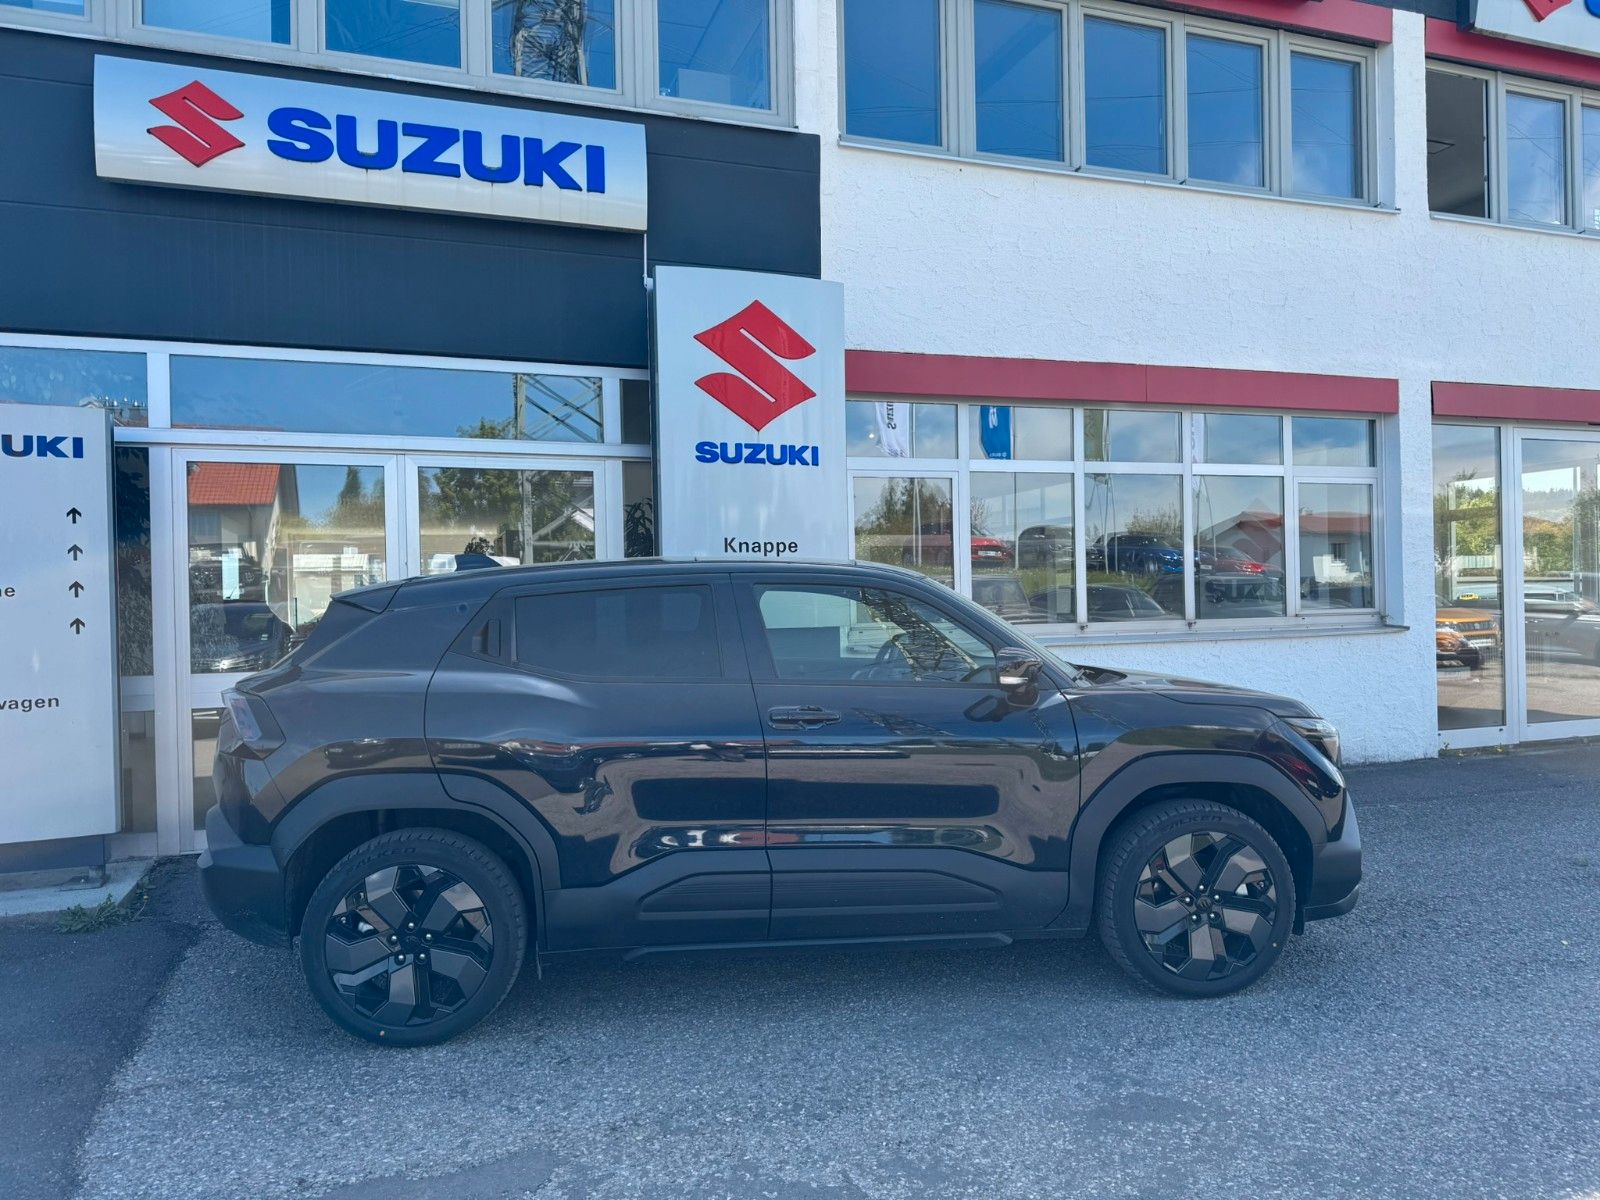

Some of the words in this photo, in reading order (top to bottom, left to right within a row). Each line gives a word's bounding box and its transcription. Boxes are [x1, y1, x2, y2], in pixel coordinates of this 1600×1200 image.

[267, 106, 606, 194] SUZUKI
[695, 441, 819, 467] SUZUKI
[724, 537, 799, 557] Knappe
[0, 587, 16, 598] e
